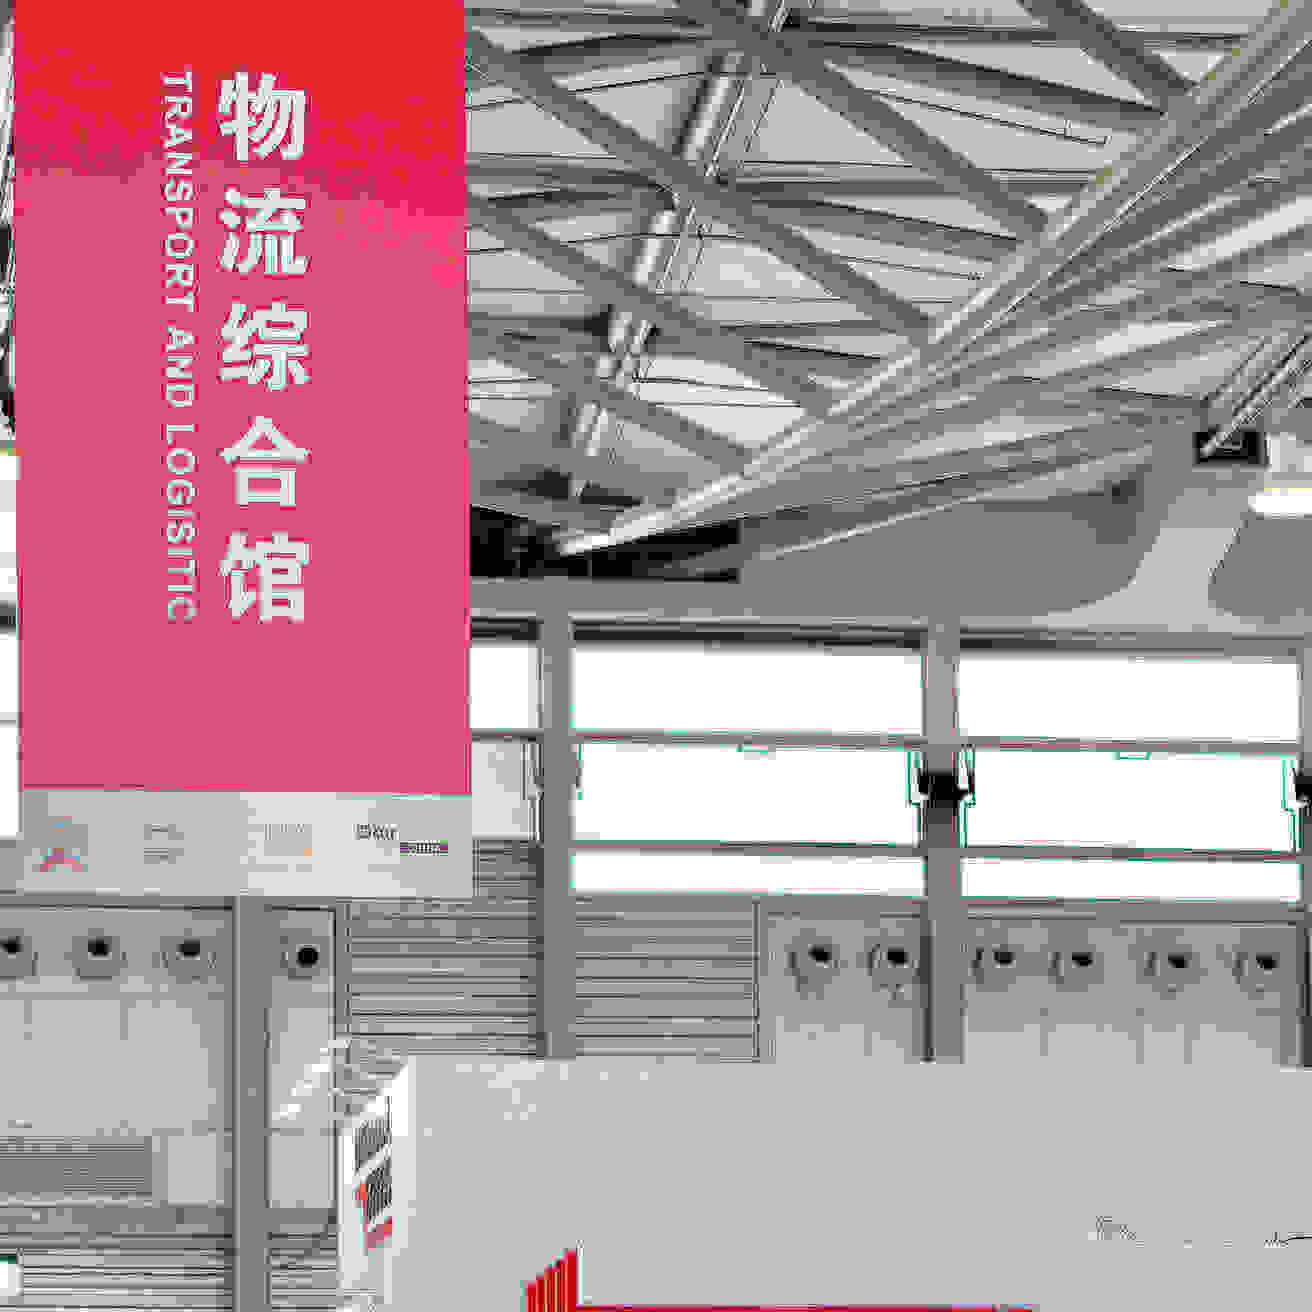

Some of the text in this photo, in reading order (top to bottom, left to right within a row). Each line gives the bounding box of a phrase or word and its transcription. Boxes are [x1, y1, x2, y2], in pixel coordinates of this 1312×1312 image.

[163, 72, 193, 312] TRANSPORT
[165, 322, 194, 407] AND
[215, 72, 309, 622] 物流综合馆
